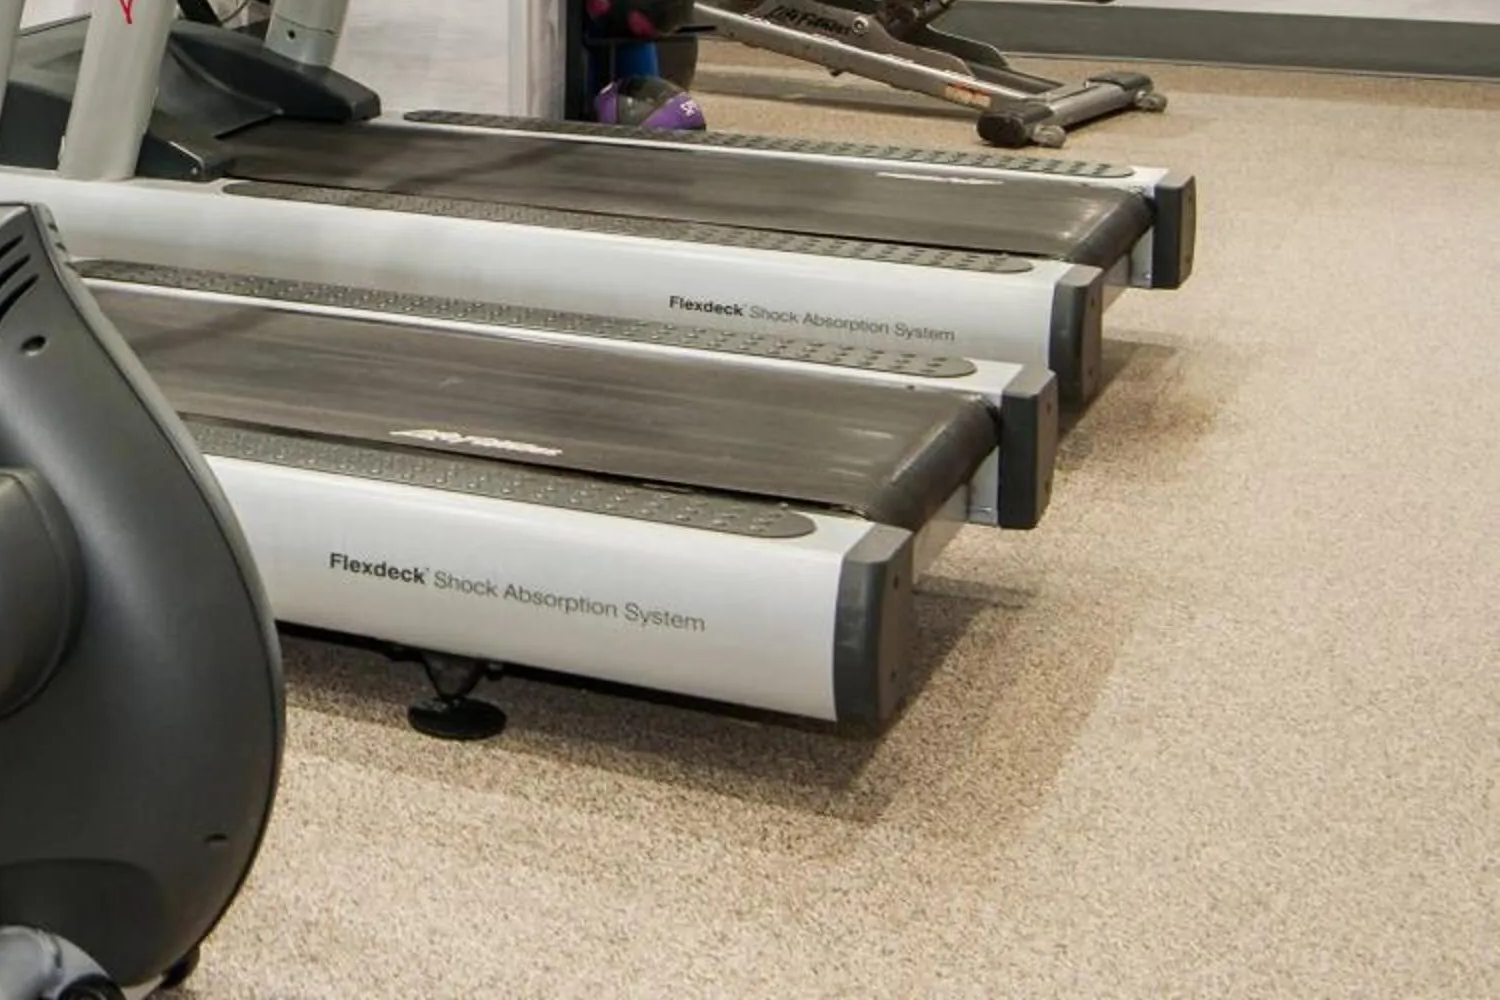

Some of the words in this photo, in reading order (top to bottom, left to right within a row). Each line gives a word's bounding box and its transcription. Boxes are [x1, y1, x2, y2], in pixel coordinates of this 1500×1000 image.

[748, 304, 799, 324] Shock
[802, 312, 889, 336] Absorption
[894, 321, 955, 342] System
[433, 569, 499, 599] Shock
[502, 583, 619, 617] Absorption
[624, 602, 706, 633] System
